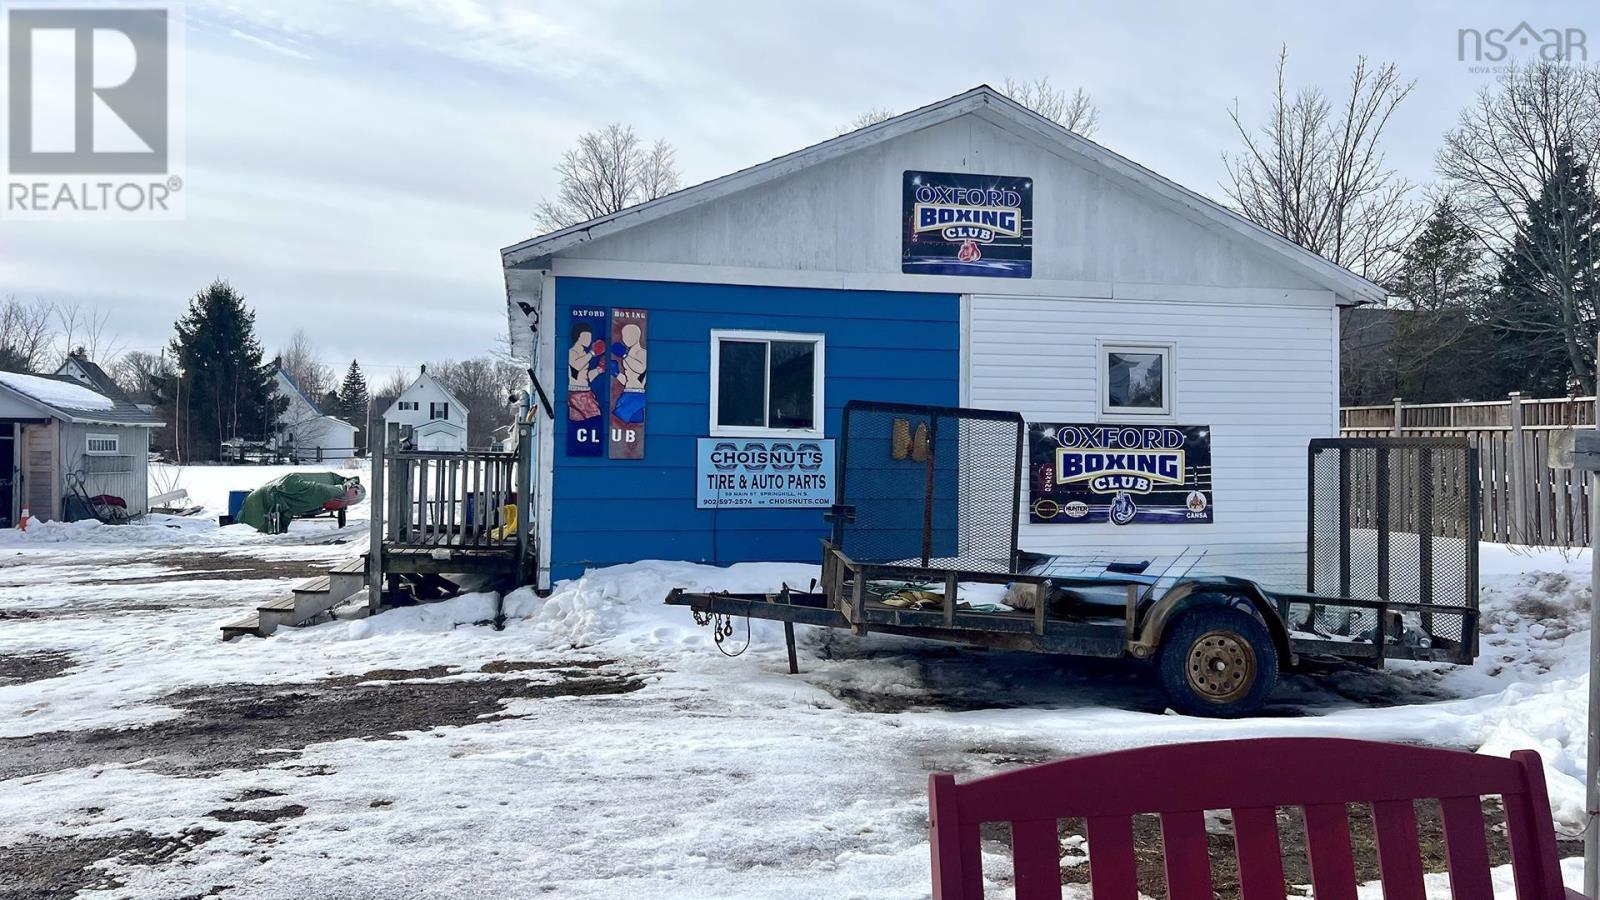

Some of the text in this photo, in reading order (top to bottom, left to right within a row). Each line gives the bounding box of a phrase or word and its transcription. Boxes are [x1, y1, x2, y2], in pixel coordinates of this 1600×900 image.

[915, 185, 1022, 208] OXFORD
[920, 207, 1016, 232] BOXING
[945, 227, 992, 240] CLUB
[572, 309, 646, 319] OXFORD BOXING
[1057, 426, 1186, 449] OXFORD
[710, 452, 824, 464] CHOISNUT'S
[1062, 453, 1178, 480] BOXING
[707, 474, 827, 490] TIRE & AUTO PARTS
[1093, 476, 1149, 491] CLUB
